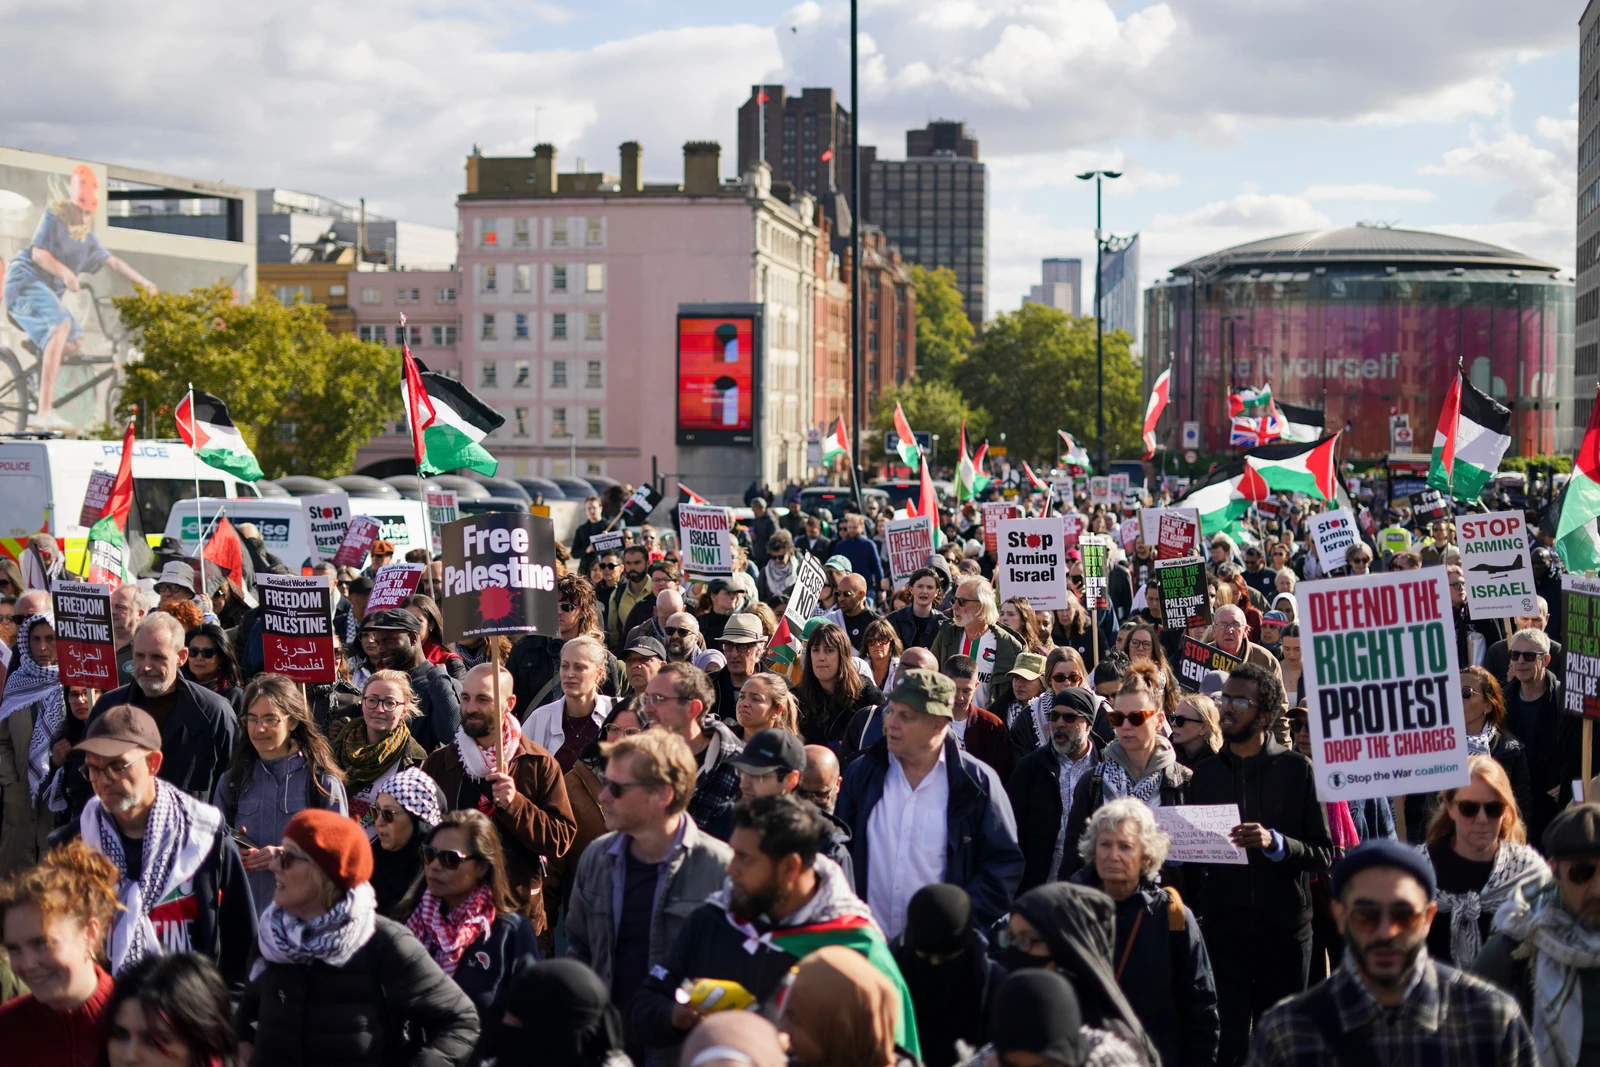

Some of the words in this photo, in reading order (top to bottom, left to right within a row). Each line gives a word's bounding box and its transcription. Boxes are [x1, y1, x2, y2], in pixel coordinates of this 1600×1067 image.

[1283, 351, 1399, 384] yourself
[445, 507, 456, 521] TO
[680, 512, 728, 530] SANCTION
[311, 521, 348, 533] Arming
[1171, 519, 1181, 528] NOT
[1178, 527, 1185, 536] TO
[1461, 517, 1520, 539] STOP
[463, 524, 529, 557] Free
[690, 529, 720, 546] ISRAEL
[889, 528, 932, 554] FREEDOM
[1008, 531, 1053, 550] Stop
[1160, 536, 1184, 549] GENOCIDE
[1170, 533, 1192, 544] AGAINST
[1319, 530, 1354, 544] Arming
[1464, 537, 1524, 554] ARMING
[1006, 552, 1057, 566] Arming
[388, 571, 402, 581] NOT
[402, 571, 409, 580] A
[444, 556, 555, 598] Palestine
[1010, 567, 1055, 582] Israel
[1161, 568, 1183, 578] FROM
[1185, 565, 1199, 576] THE
[59, 584, 80, 592] Socialist
[80, 586, 101, 594] Worker
[265, 577, 292, 586] Socialist
[374, 580, 393, 590] CRIME
[393, 580, 403, 588] TO
[1162, 578, 1184, 589] RIVER
[1186, 576, 1197, 586] TO
[1570, 580, 1589, 589] Socialist
[265, 588, 322, 609] FREEDOM
[381, 588, 412, 597] AGAINST
[1163, 588, 1179, 598] THE
[1181, 587, 1195, 597] SEA
[1471, 582, 1531, 599] ISRAEL
[57, 596, 105, 616] FREEDOM
[368, 597, 399, 608] GENOCIDE
[1165, 594, 1204, 609] PALESTINE
[1308, 584, 1399, 633] DEFEND
[1398, 579, 1442, 623] THE
[1568, 593, 1589, 616] FROM
[287, 608, 297, 616] for
[1166, 608, 1185, 619] WILL
[1186, 606, 1197, 617] BE
[57, 620, 110, 641] PALESTINE
[264, 613, 328, 634] PALESTINE
[1167, 617, 1187, 629] FREE
[1568, 613, 1589, 635] RIVER
[276, 638, 317, 658] الحرية
[1567, 632, 1582, 653] THE
[1582, 635, 1600, 656] SEA
[68, 644, 102, 663] الحرية
[1184, 641, 1211, 664] STOP
[1313, 626, 1406, 686] RIGHT
[1408, 621, 1448, 676] TO
[66, 662, 109, 678] لفلسطين
[274, 656, 325, 671] لفلسطين
[1565, 671, 1583, 693] WILL
[1584, 676, 1598, 697] BE
[1318, 675, 1451, 739] PROTEST
[1564, 690, 1584, 713] FREE
[1323, 738, 1363, 765] DROP
[1365, 733, 1391, 760] THE
[1393, 726, 1456, 757] CHARGES
[1346, 772, 1371, 785] Stop
[1373, 770, 1390, 781] the
[1392, 768, 1413, 779] War
[1414, 763, 1459, 777] coalition
[1192, 805, 1237, 819] STEEZE
[1172, 821, 1184, 830] TO
